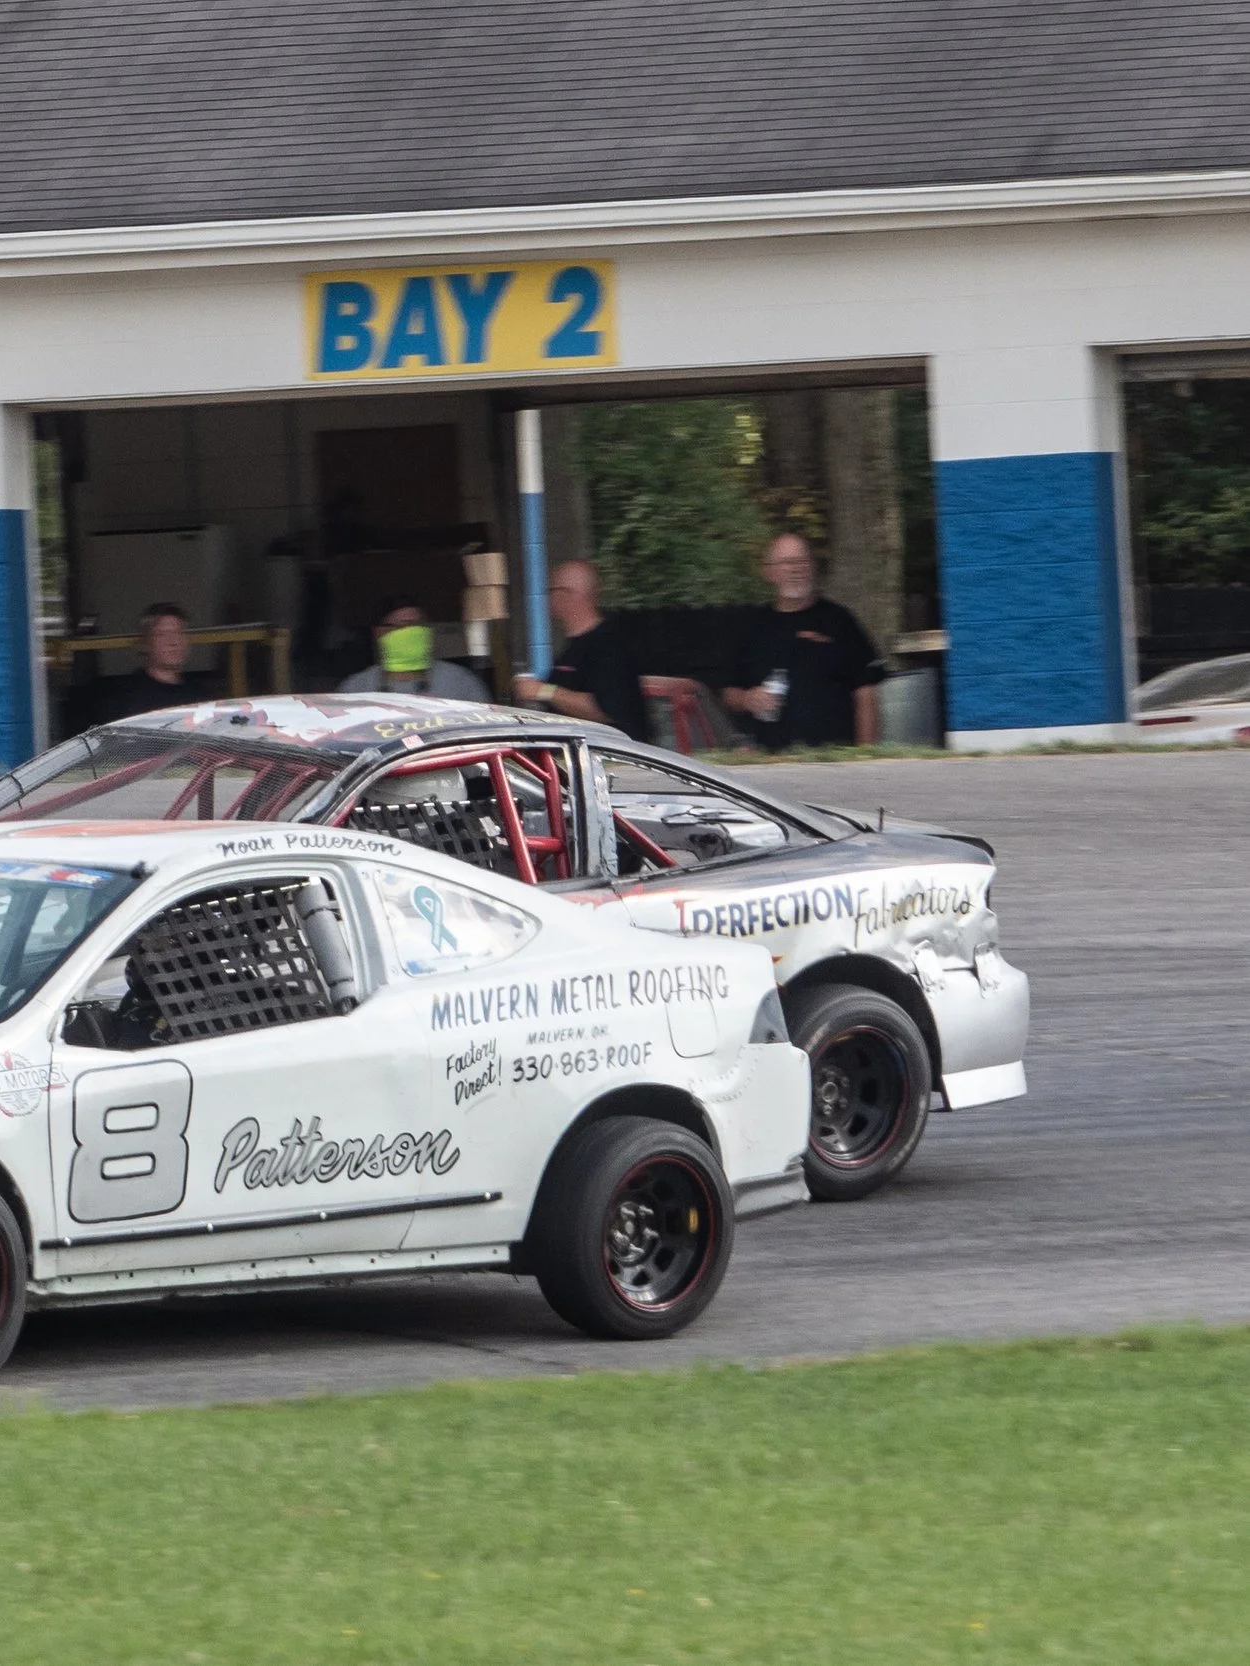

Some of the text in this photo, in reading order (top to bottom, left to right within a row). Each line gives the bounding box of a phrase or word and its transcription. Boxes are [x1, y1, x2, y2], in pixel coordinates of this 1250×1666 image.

[315, 265, 606, 374] BAY 2
[284, 833, 402, 856] Patterson
[431, 963, 730, 1032] MALVERN METAL ROOFING
[4, 1066, 62, 1090] MOTORS
[446, 1038, 498, 1080] Factory
[454, 1053, 502, 1106] Direct!
[66, 1058, 193, 1224] 8
[213, 1115, 462, 1194] Patterson
